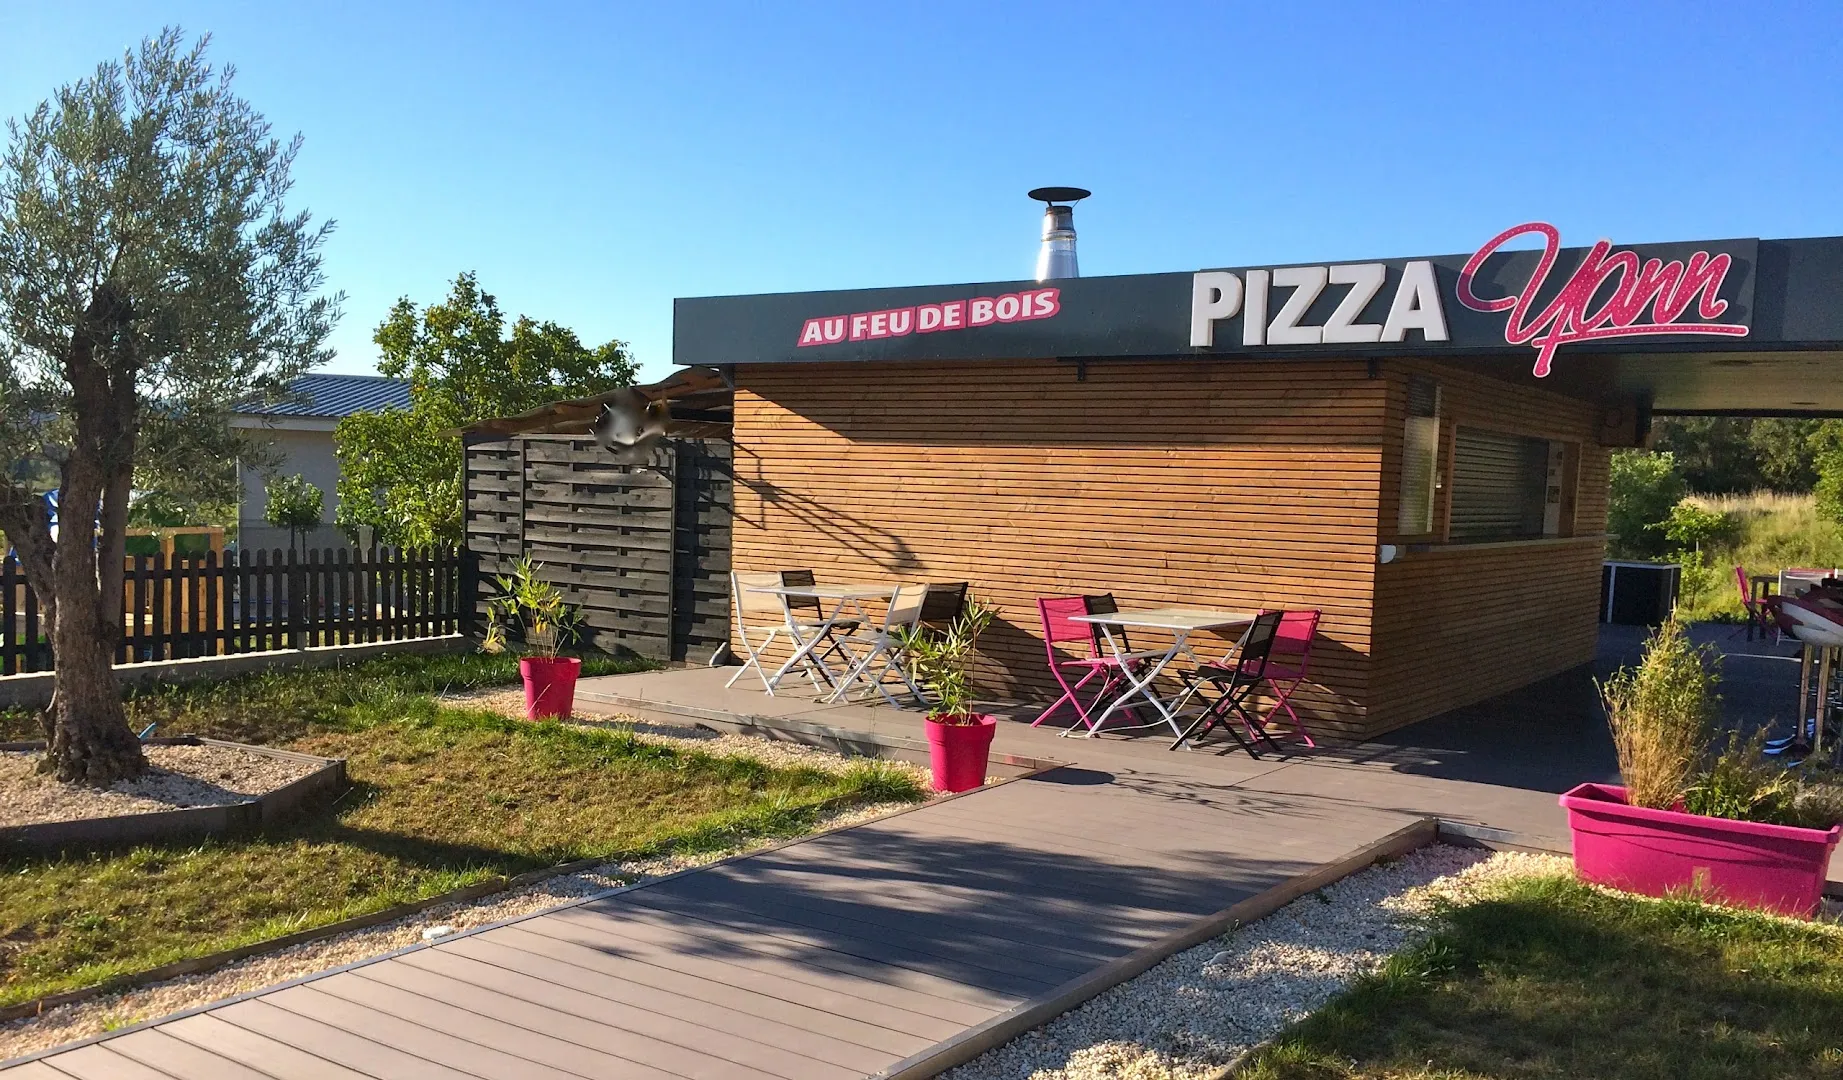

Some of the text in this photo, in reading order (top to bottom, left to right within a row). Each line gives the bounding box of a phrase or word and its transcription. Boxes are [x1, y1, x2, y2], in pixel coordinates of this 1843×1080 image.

[802, 291, 1055, 344] AU FEU DE BOIS
[1190, 261, 1449, 347] PIZZA
